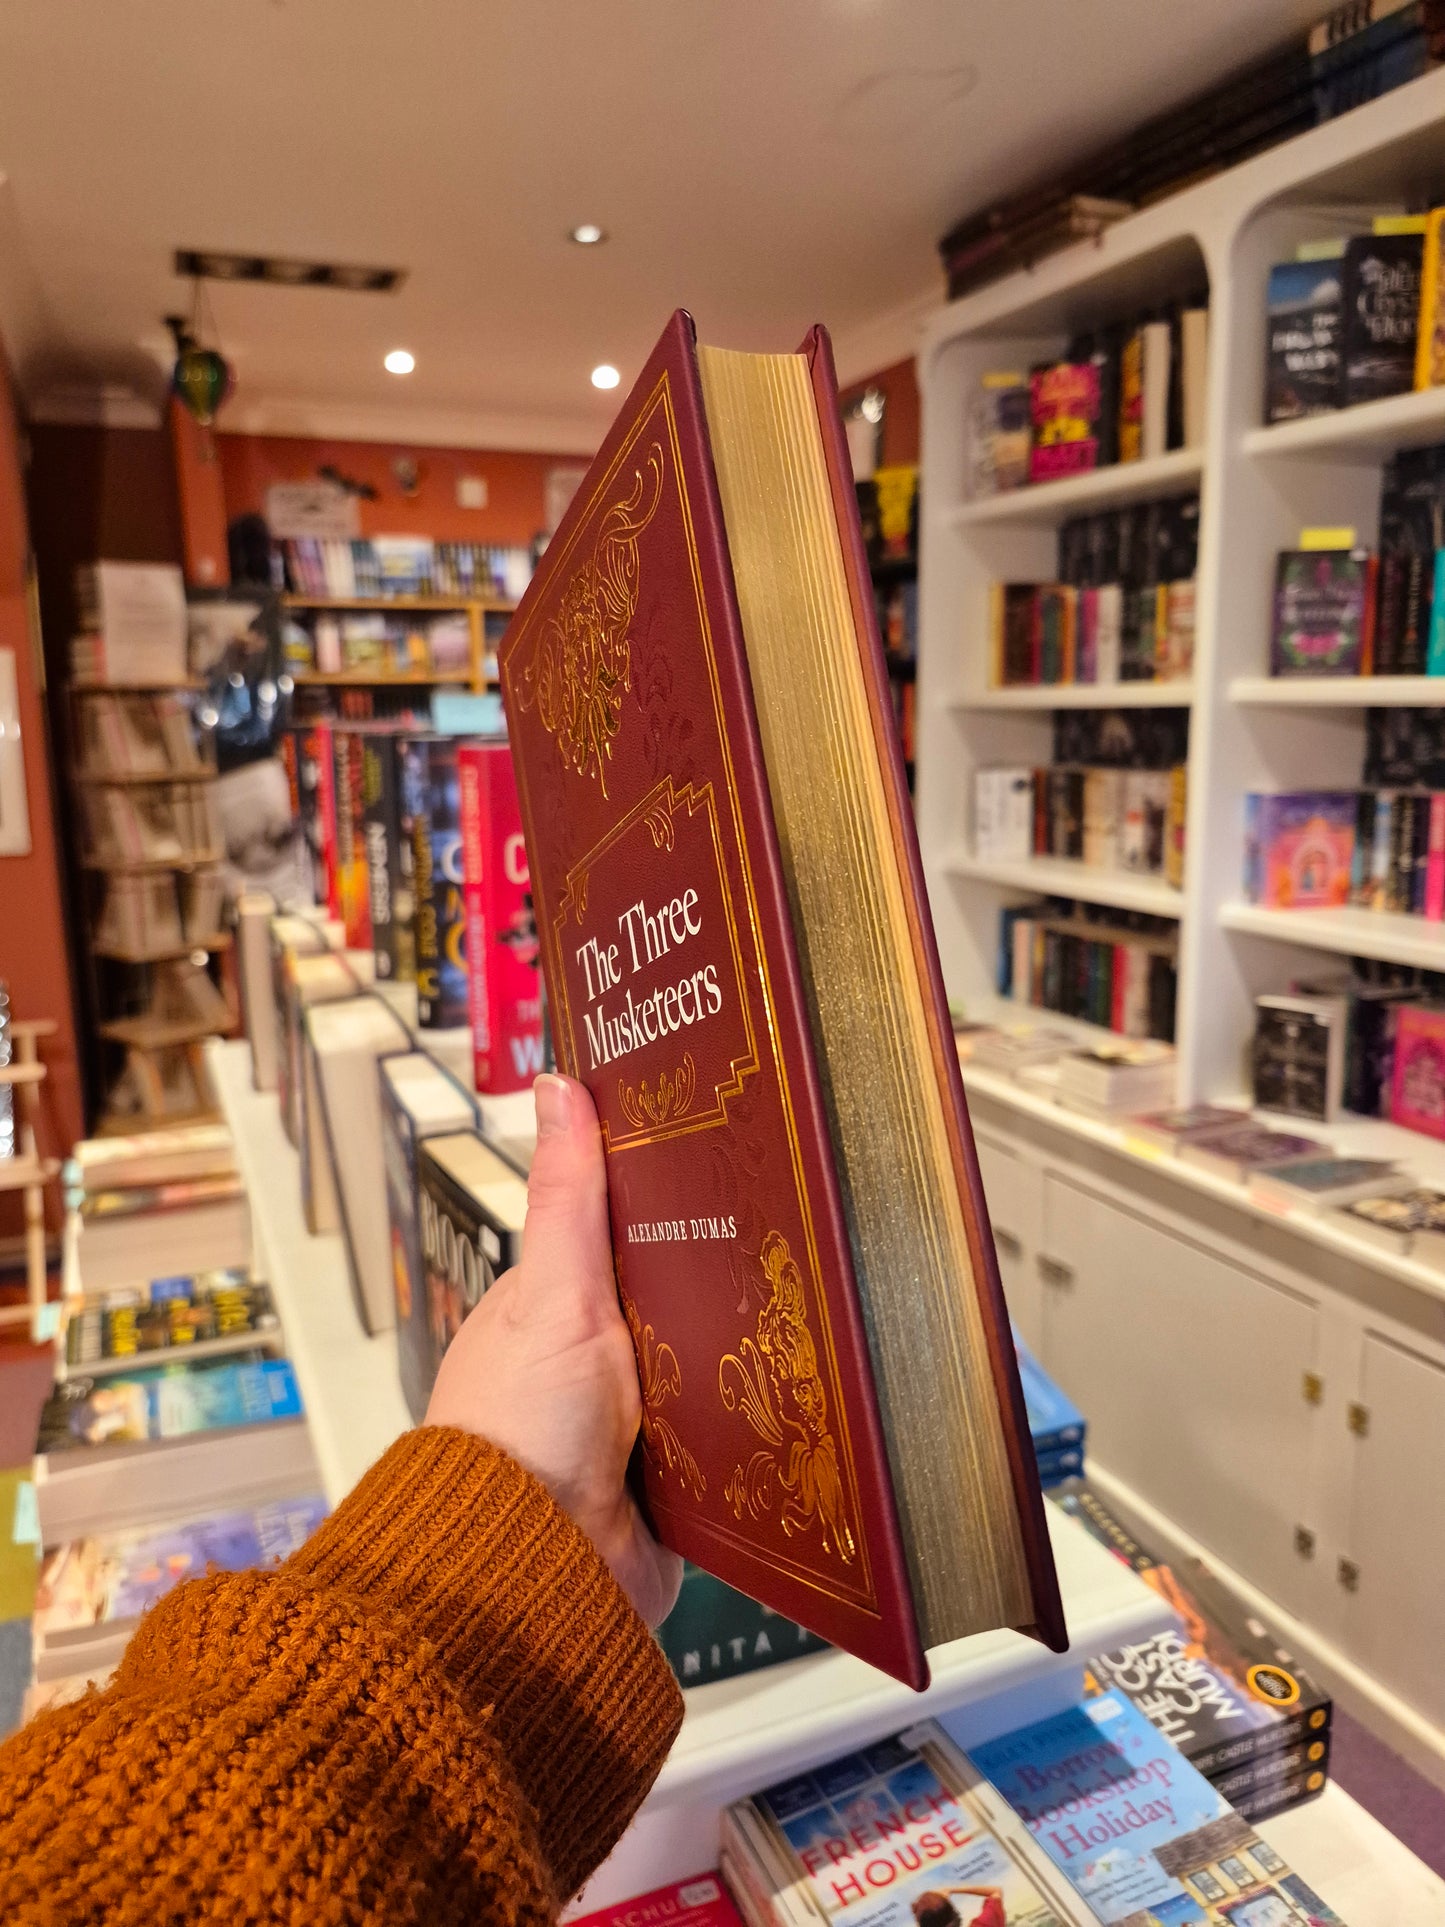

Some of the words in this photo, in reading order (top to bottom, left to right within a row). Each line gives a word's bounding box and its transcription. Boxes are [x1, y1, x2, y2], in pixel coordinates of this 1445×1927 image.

[576, 936, 623, 1003] The
[618, 887, 703, 975] Three
[583, 964, 722, 1071] Musketeers
[627, 1219, 688, 1243] ALEXANDRE
[689, 1215, 738, 1240] DUMAS
[799, 1784, 960, 1879] FRENCH
[830, 1819, 974, 1907] HOUSE
[1048, 1794, 1179, 1860] Holiday
